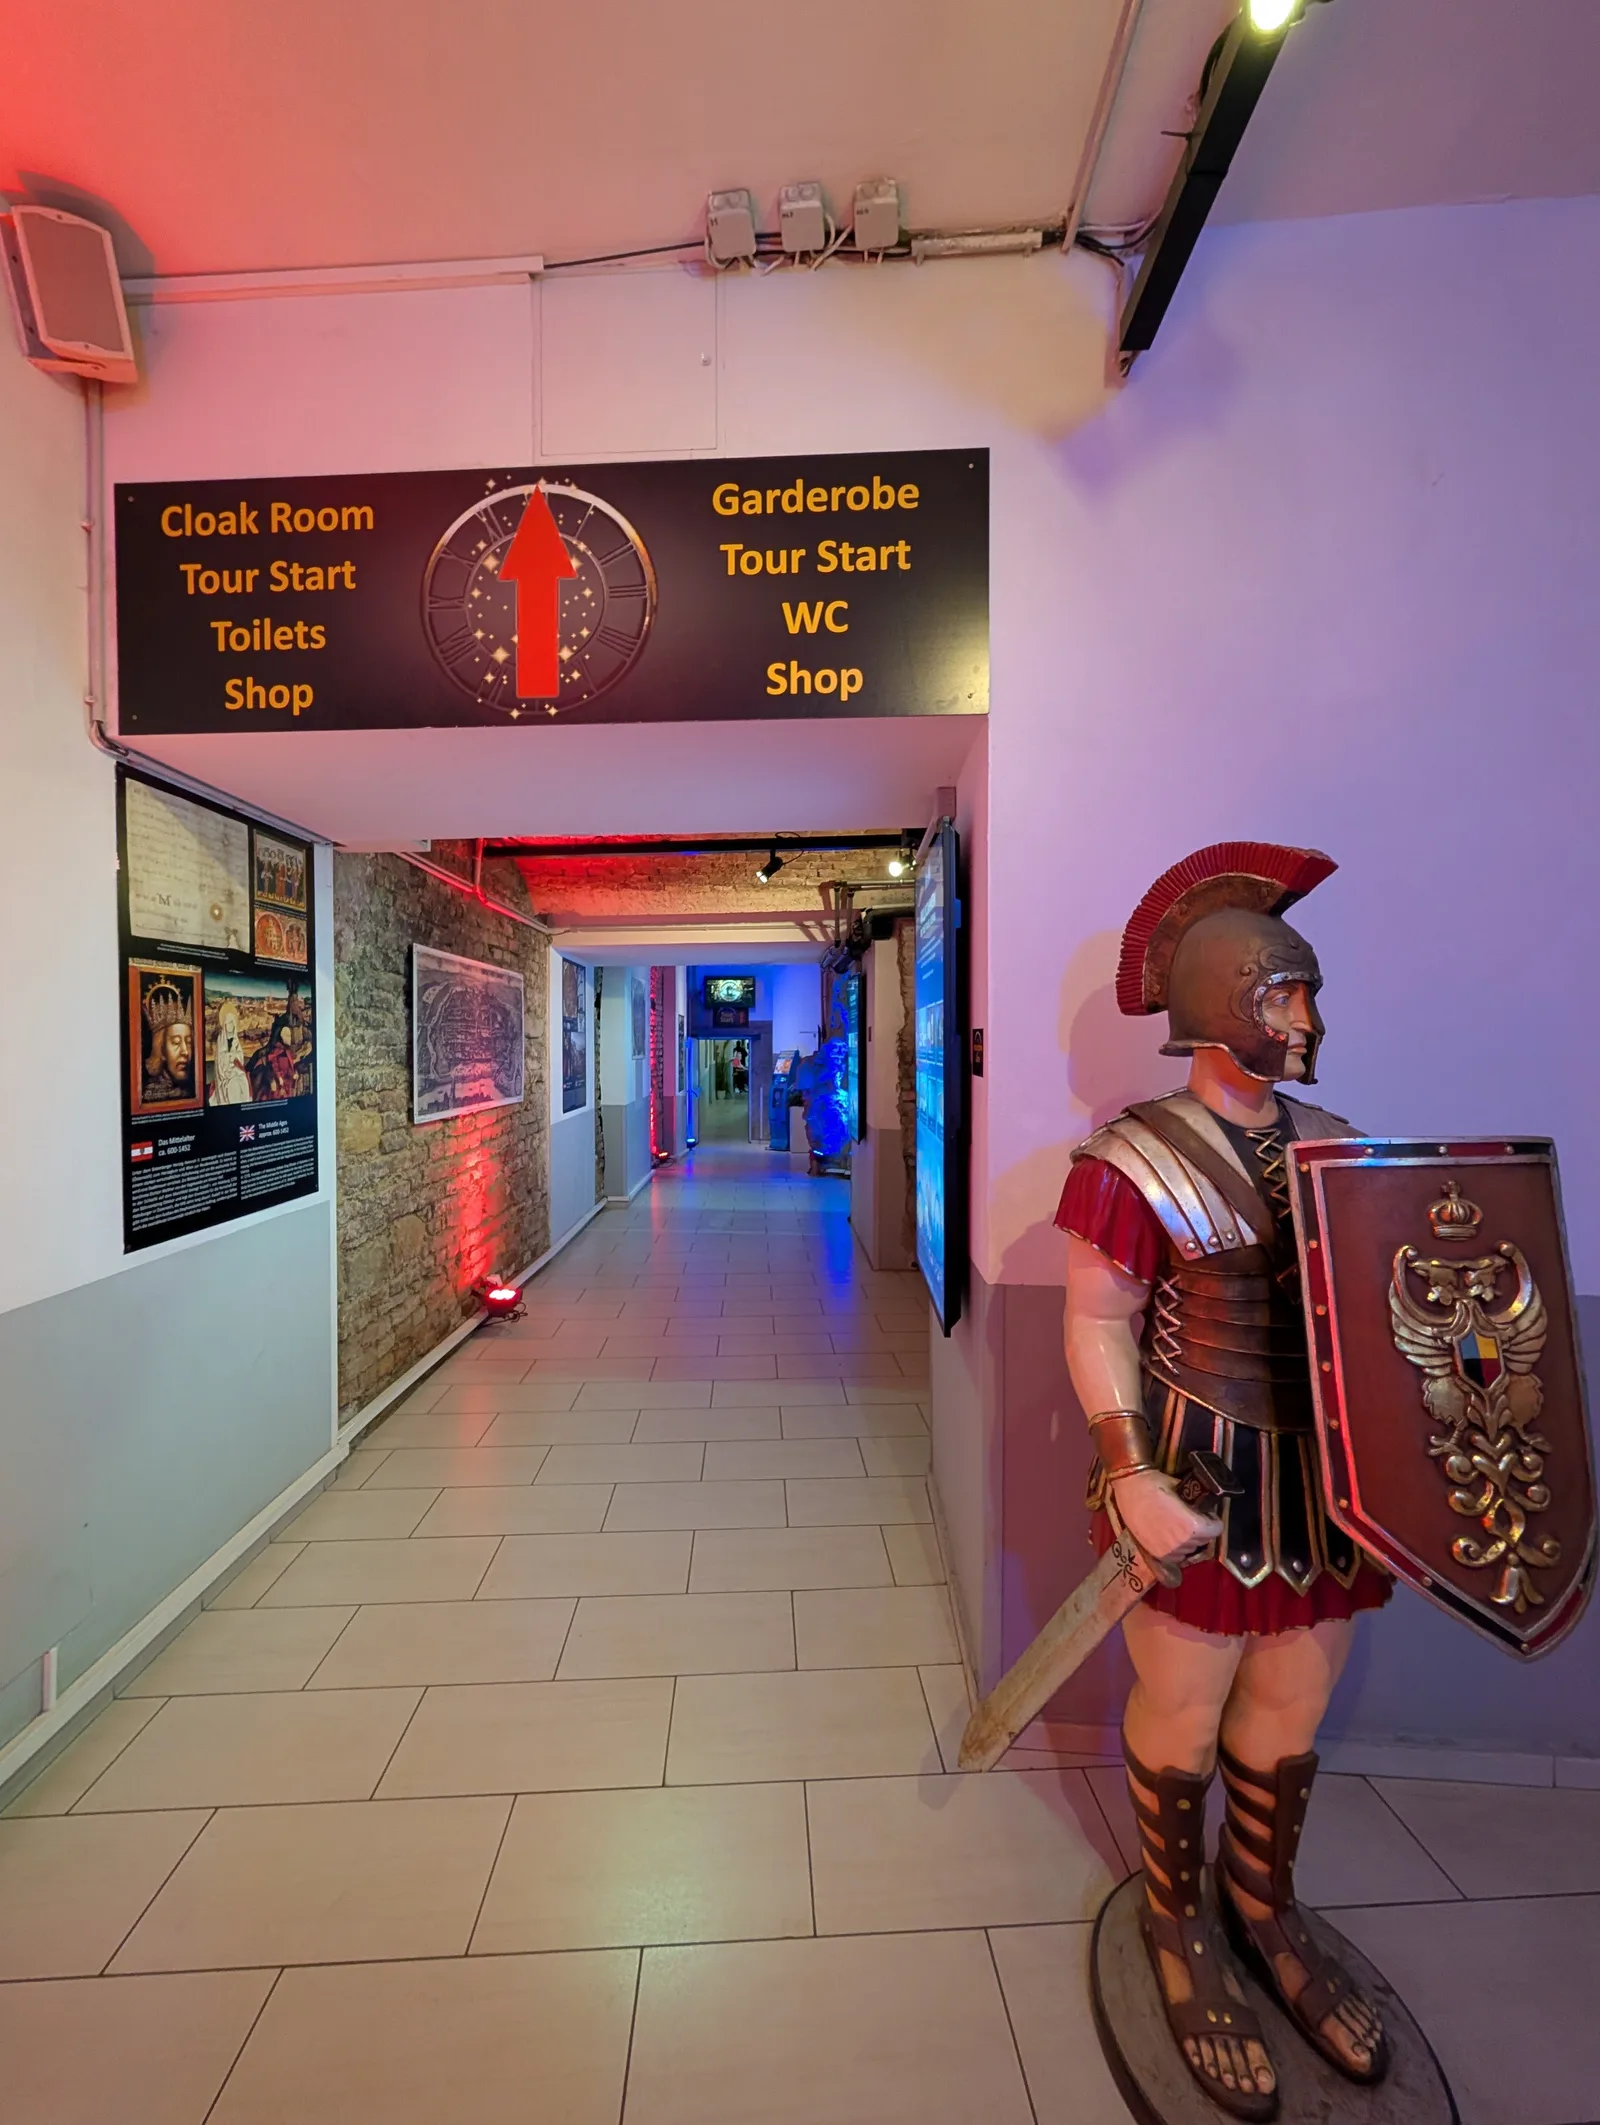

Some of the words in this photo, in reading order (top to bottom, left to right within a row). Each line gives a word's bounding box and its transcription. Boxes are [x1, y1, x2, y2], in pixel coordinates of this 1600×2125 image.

[712, 475, 920, 516] Garderobe
[161, 502, 259, 537] Cloak
[270, 501, 375, 534] Room
[719, 542, 806, 576] Tour
[816, 539, 912, 573] Start
[180, 562, 260, 595] Tour
[268, 559, 357, 592] Start
[210, 617, 327, 652] Toilets
[781, 600, 849, 635] WC
[224, 676, 314, 716] Shop
[766, 660, 864, 702] Shop
[158, 1138, 169, 1147] Das
[169, 1134, 196, 1145] Mittelalter
[158, 1149, 167, 1157] ca.
[167, 1144, 191, 1155] 600-1452
